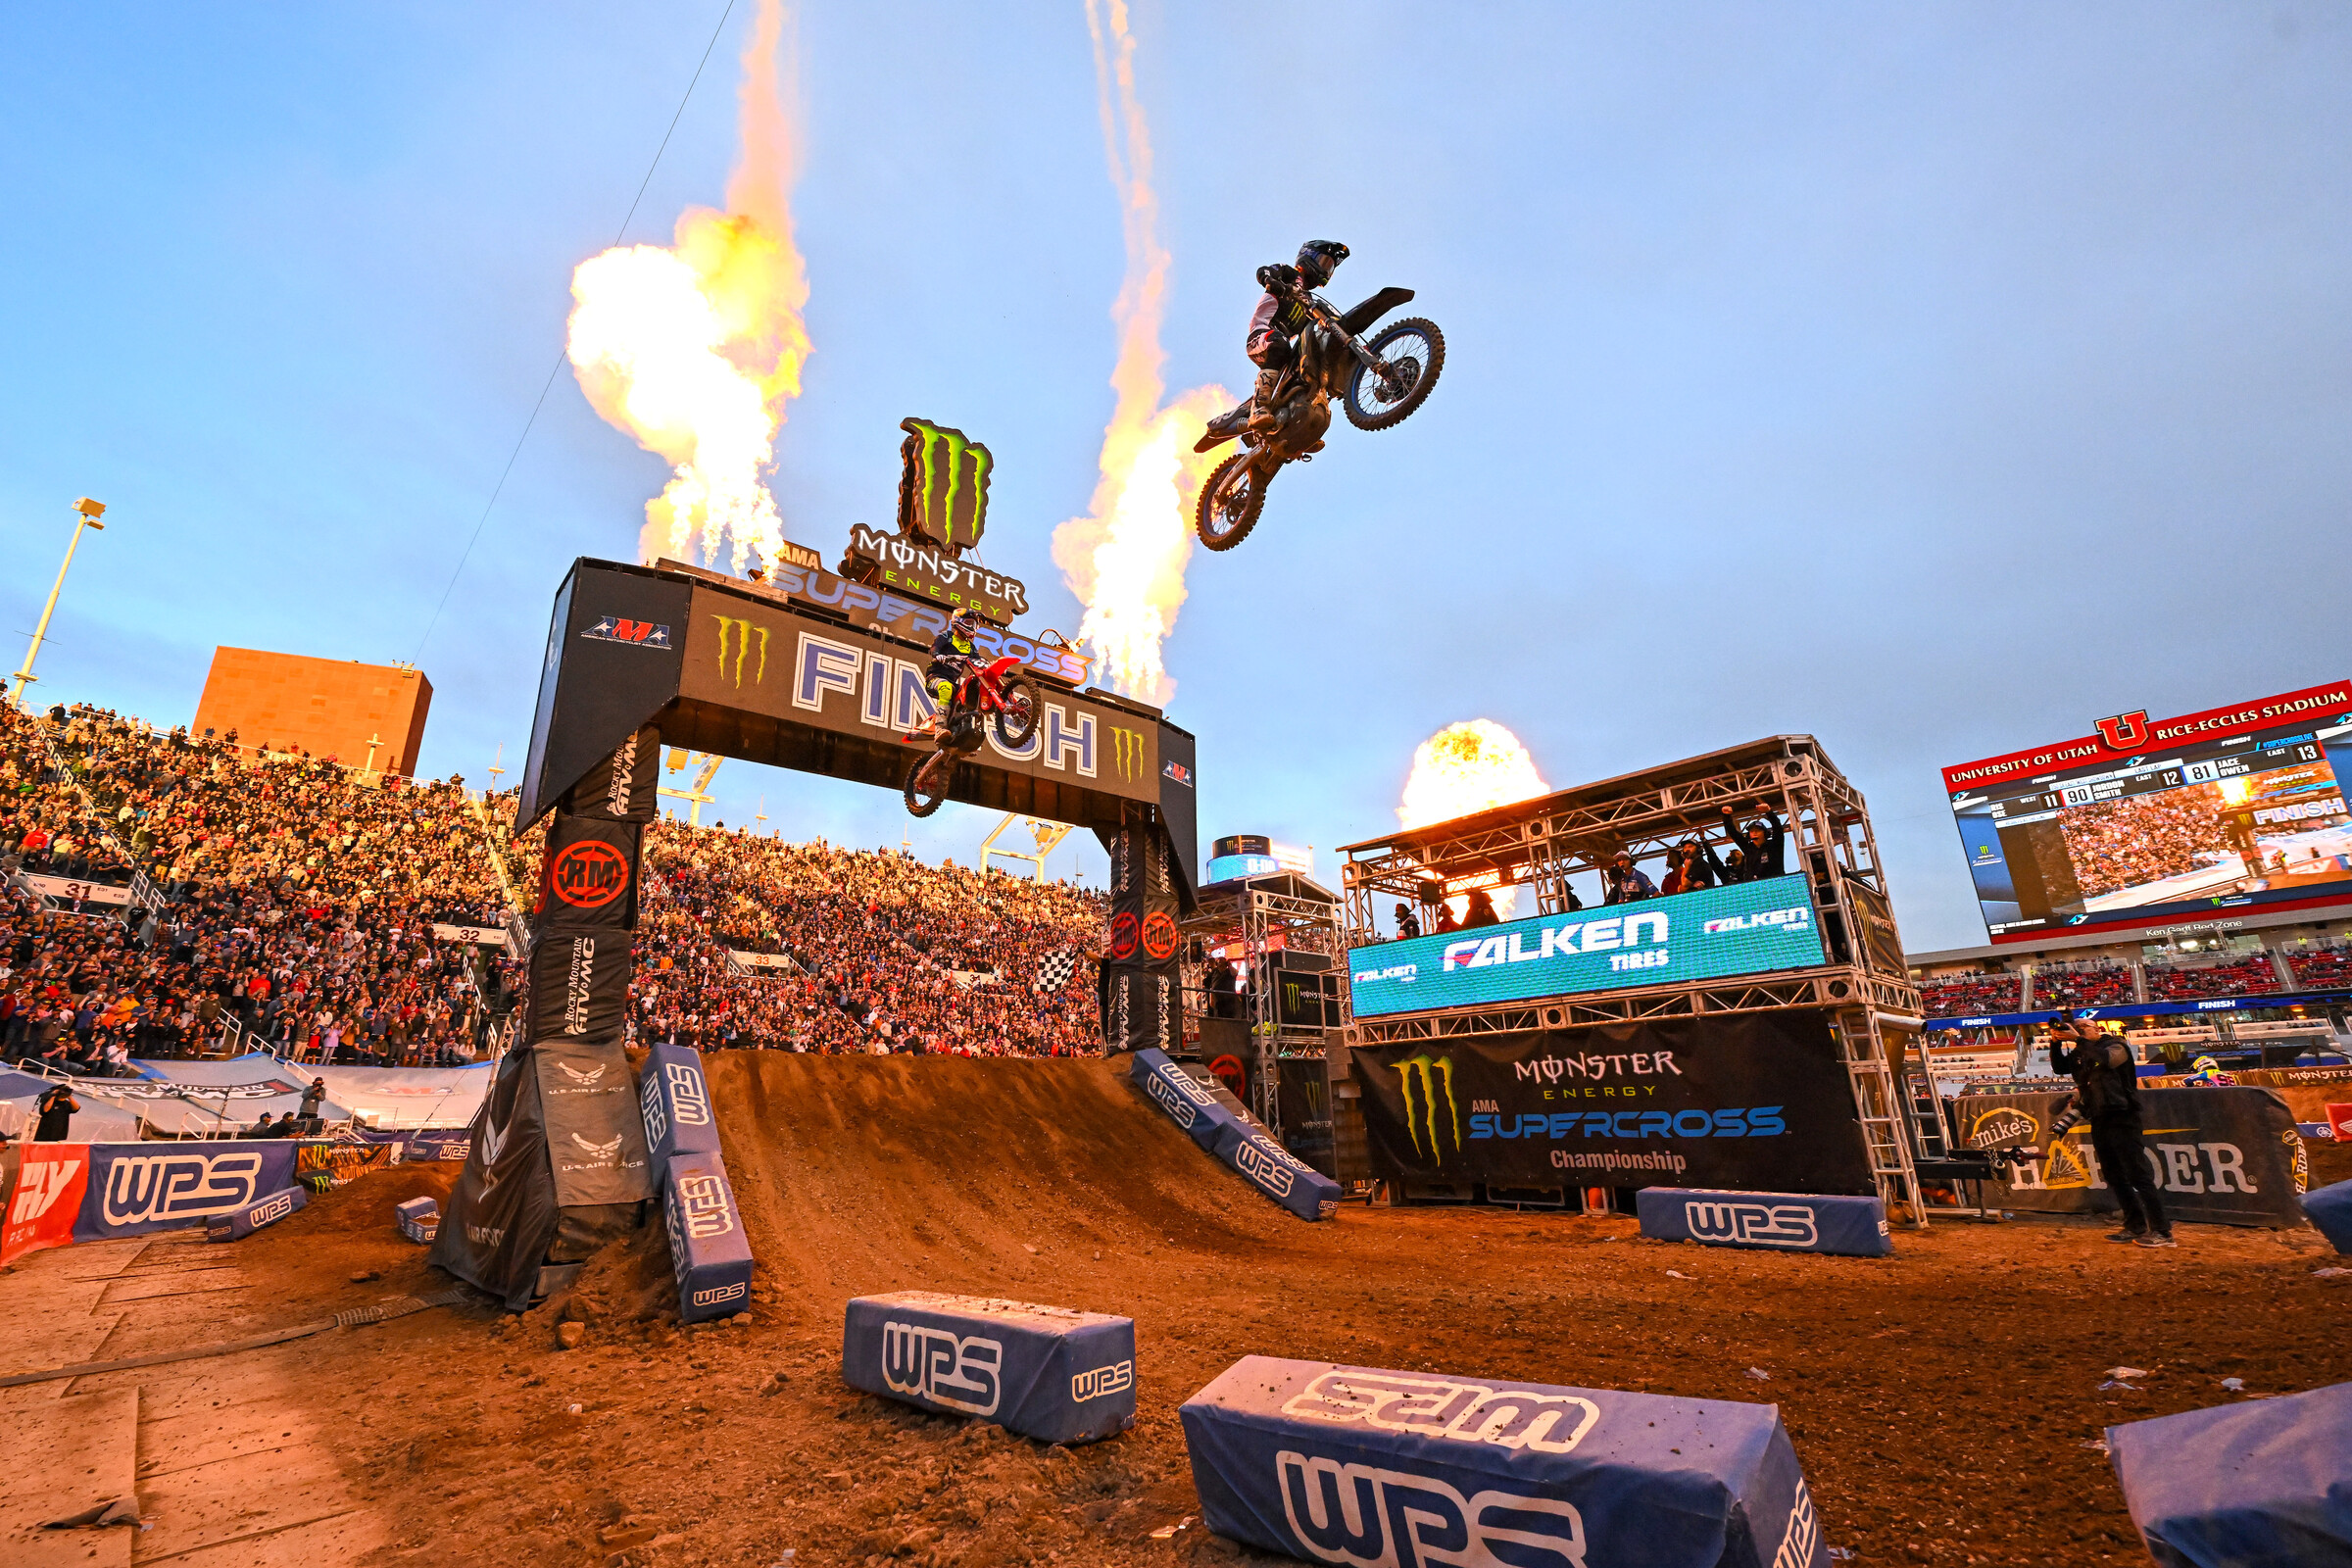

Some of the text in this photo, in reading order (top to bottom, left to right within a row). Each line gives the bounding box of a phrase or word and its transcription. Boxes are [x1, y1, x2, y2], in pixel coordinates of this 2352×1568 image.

[779, 546, 819, 570] AMA
[858, 529, 1025, 609] MONSTER
[884, 569, 1002, 616] ENERGY
[580, 615, 672, 647] AMA
[772, 564, 1095, 678] SUPERROSS
[792, 631, 1099, 779] FINSH
[2156, 691, 2348, 740] RICE-ECCLES STADIUM
[2093, 710, 2150, 751] U
[2221, 735, 2252, 747] FINISH
[1950, 744, 2098, 783] UNIVERSITY OF UTAH
[2217, 757, 2240, 769] JACE
[2267, 748, 2286, 757] EAST
[2297, 744, 2318, 760] 13
[2135, 772, 2153, 782] EAST
[2162, 770, 2180, 786] 12
[2192, 764, 2211, 780] 81
[2219, 763, 2250, 777] OWEN
[608, 769, 621, 800] ROCKY
[2068, 788, 2088, 804] 90
[2093, 788, 2123, 800] SMITH
[2044, 794, 2058, 808] 11
[2253, 797, 2348, 825] FINISH
[65, 882, 92, 899] 31
[1703, 906, 1809, 934] FALKEN
[2216, 920, 2243, 929] Zone
[460, 929, 480, 941] 32
[1439, 910, 1669, 972] FALKEN
[755, 956, 769, 965] 33
[1609, 949, 1670, 972] TIRES
[564, 936, 583, 1022] ROCKY MOUNTAIN
[2198, 1000, 2235, 1009] FINISH
[1961, 1017, 1991, 1026] FINISH
[1512, 1050, 1683, 1085] MONSTER
[665, 1063, 710, 1126] WPS
[1158, 1062, 1217, 1106] WPS
[1544, 1085, 1658, 1100] ENERGY
[1147, 1072, 1197, 1129] WPS
[1472, 1100, 1499, 1113] AMA
[1301, 1119, 1333, 1129] MONSTER
[1469, 1105, 1786, 1139] SUPERCROSS
[1976, 1118, 2034, 1149] mike's
[440, 1145, 470, 1159] WPS
[1549, 1150, 1687, 1174] Championship
[1236, 1141, 1295, 1198] WPS
[103, 1152, 264, 1226] WPS
[250, 1195, 292, 1228] WPS
[1318, 1200, 1339, 1210] WPS
[1685, 1201, 1818, 1247] WPS
[693, 1282, 746, 1306] WPS
[883, 1321, 1002, 1416] WPS
[1072, 1360, 1132, 1402] WPS
[1280, 1371, 1600, 1453] WPS
[1276, 1449, 1588, 1568] WPS
